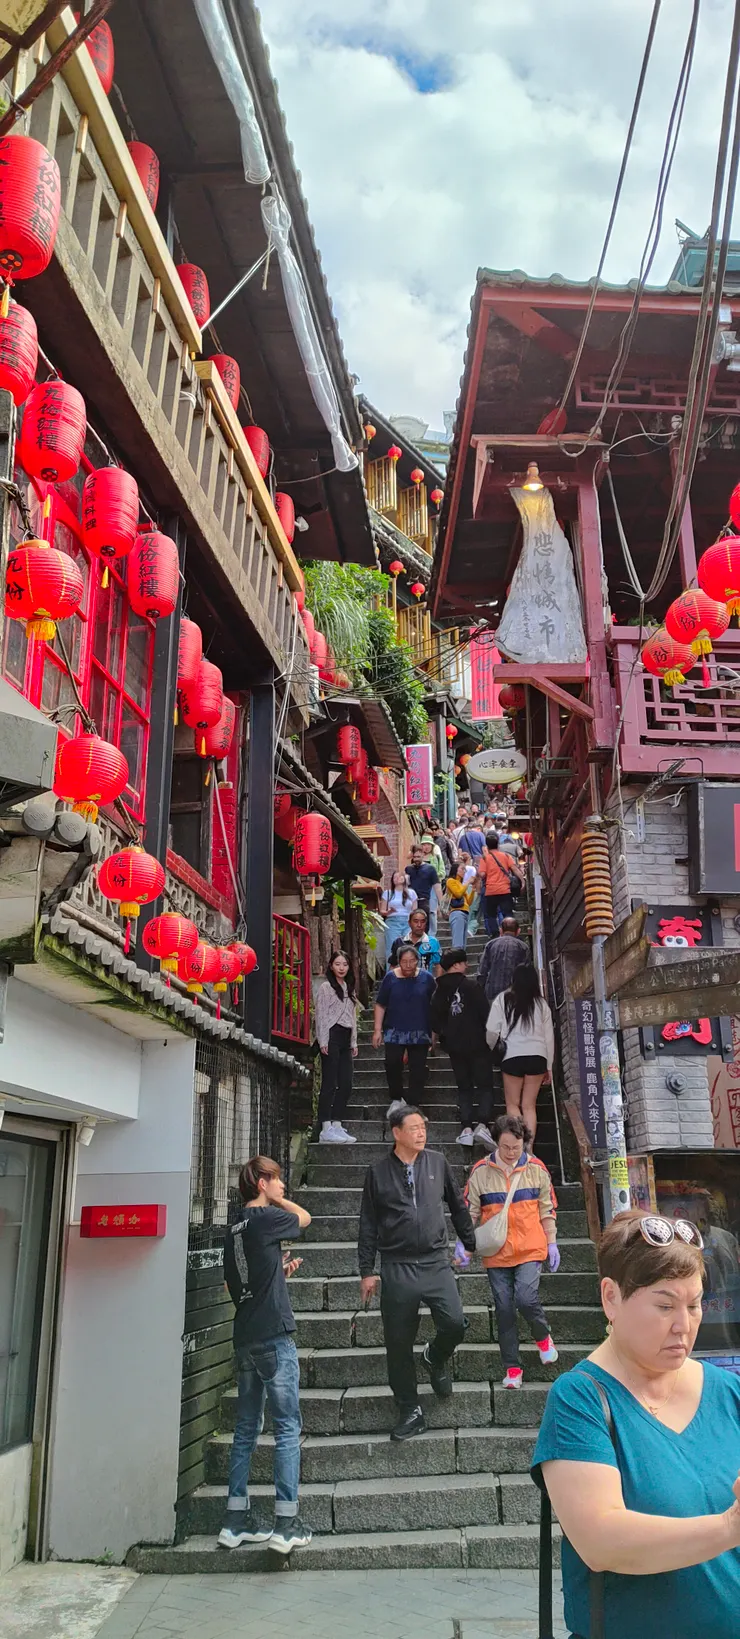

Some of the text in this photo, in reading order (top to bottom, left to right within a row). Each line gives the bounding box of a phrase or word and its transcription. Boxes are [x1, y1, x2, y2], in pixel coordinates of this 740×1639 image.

[36, 387, 64, 453] 九份紅樓
[6, 556, 25, 601] 九份
[137, 535, 161, 598] 九份紅樓
[532, 532, 561, 649] 悲情城市
[677, 596, 698, 632] 九份
[350, 727, 359, 758] 九份紅樓
[319, 820, 331, 868] 九份紅樓
[112, 856, 127, 887] 九份
[147, 922, 157, 947] 九份
[221, 952, 232, 974] 九份
[581, 1000, 597, 1069] 奇幻怪獸特展
